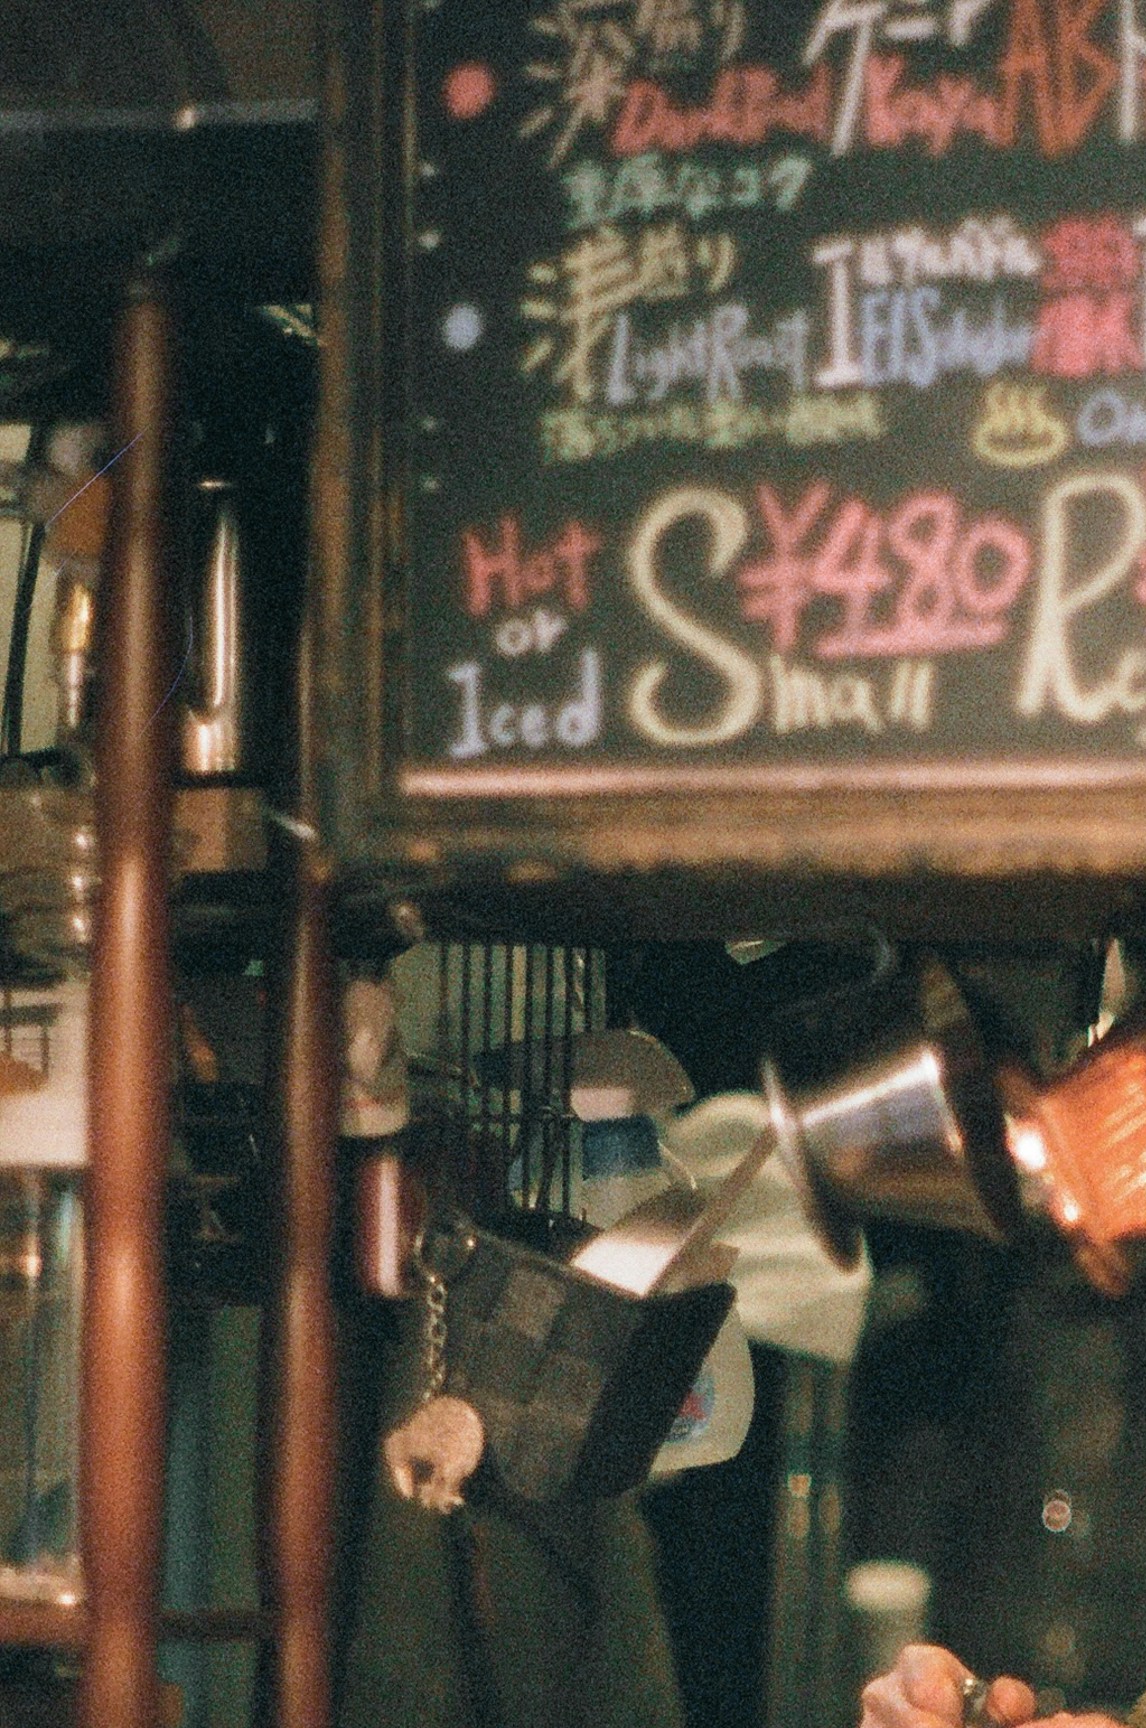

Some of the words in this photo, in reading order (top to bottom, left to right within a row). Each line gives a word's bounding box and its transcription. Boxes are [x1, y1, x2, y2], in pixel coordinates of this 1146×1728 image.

[462, 515, 597, 614] Hot
[738, 480, 1034, 658] ¥480
[496, 610, 562, 658] or
